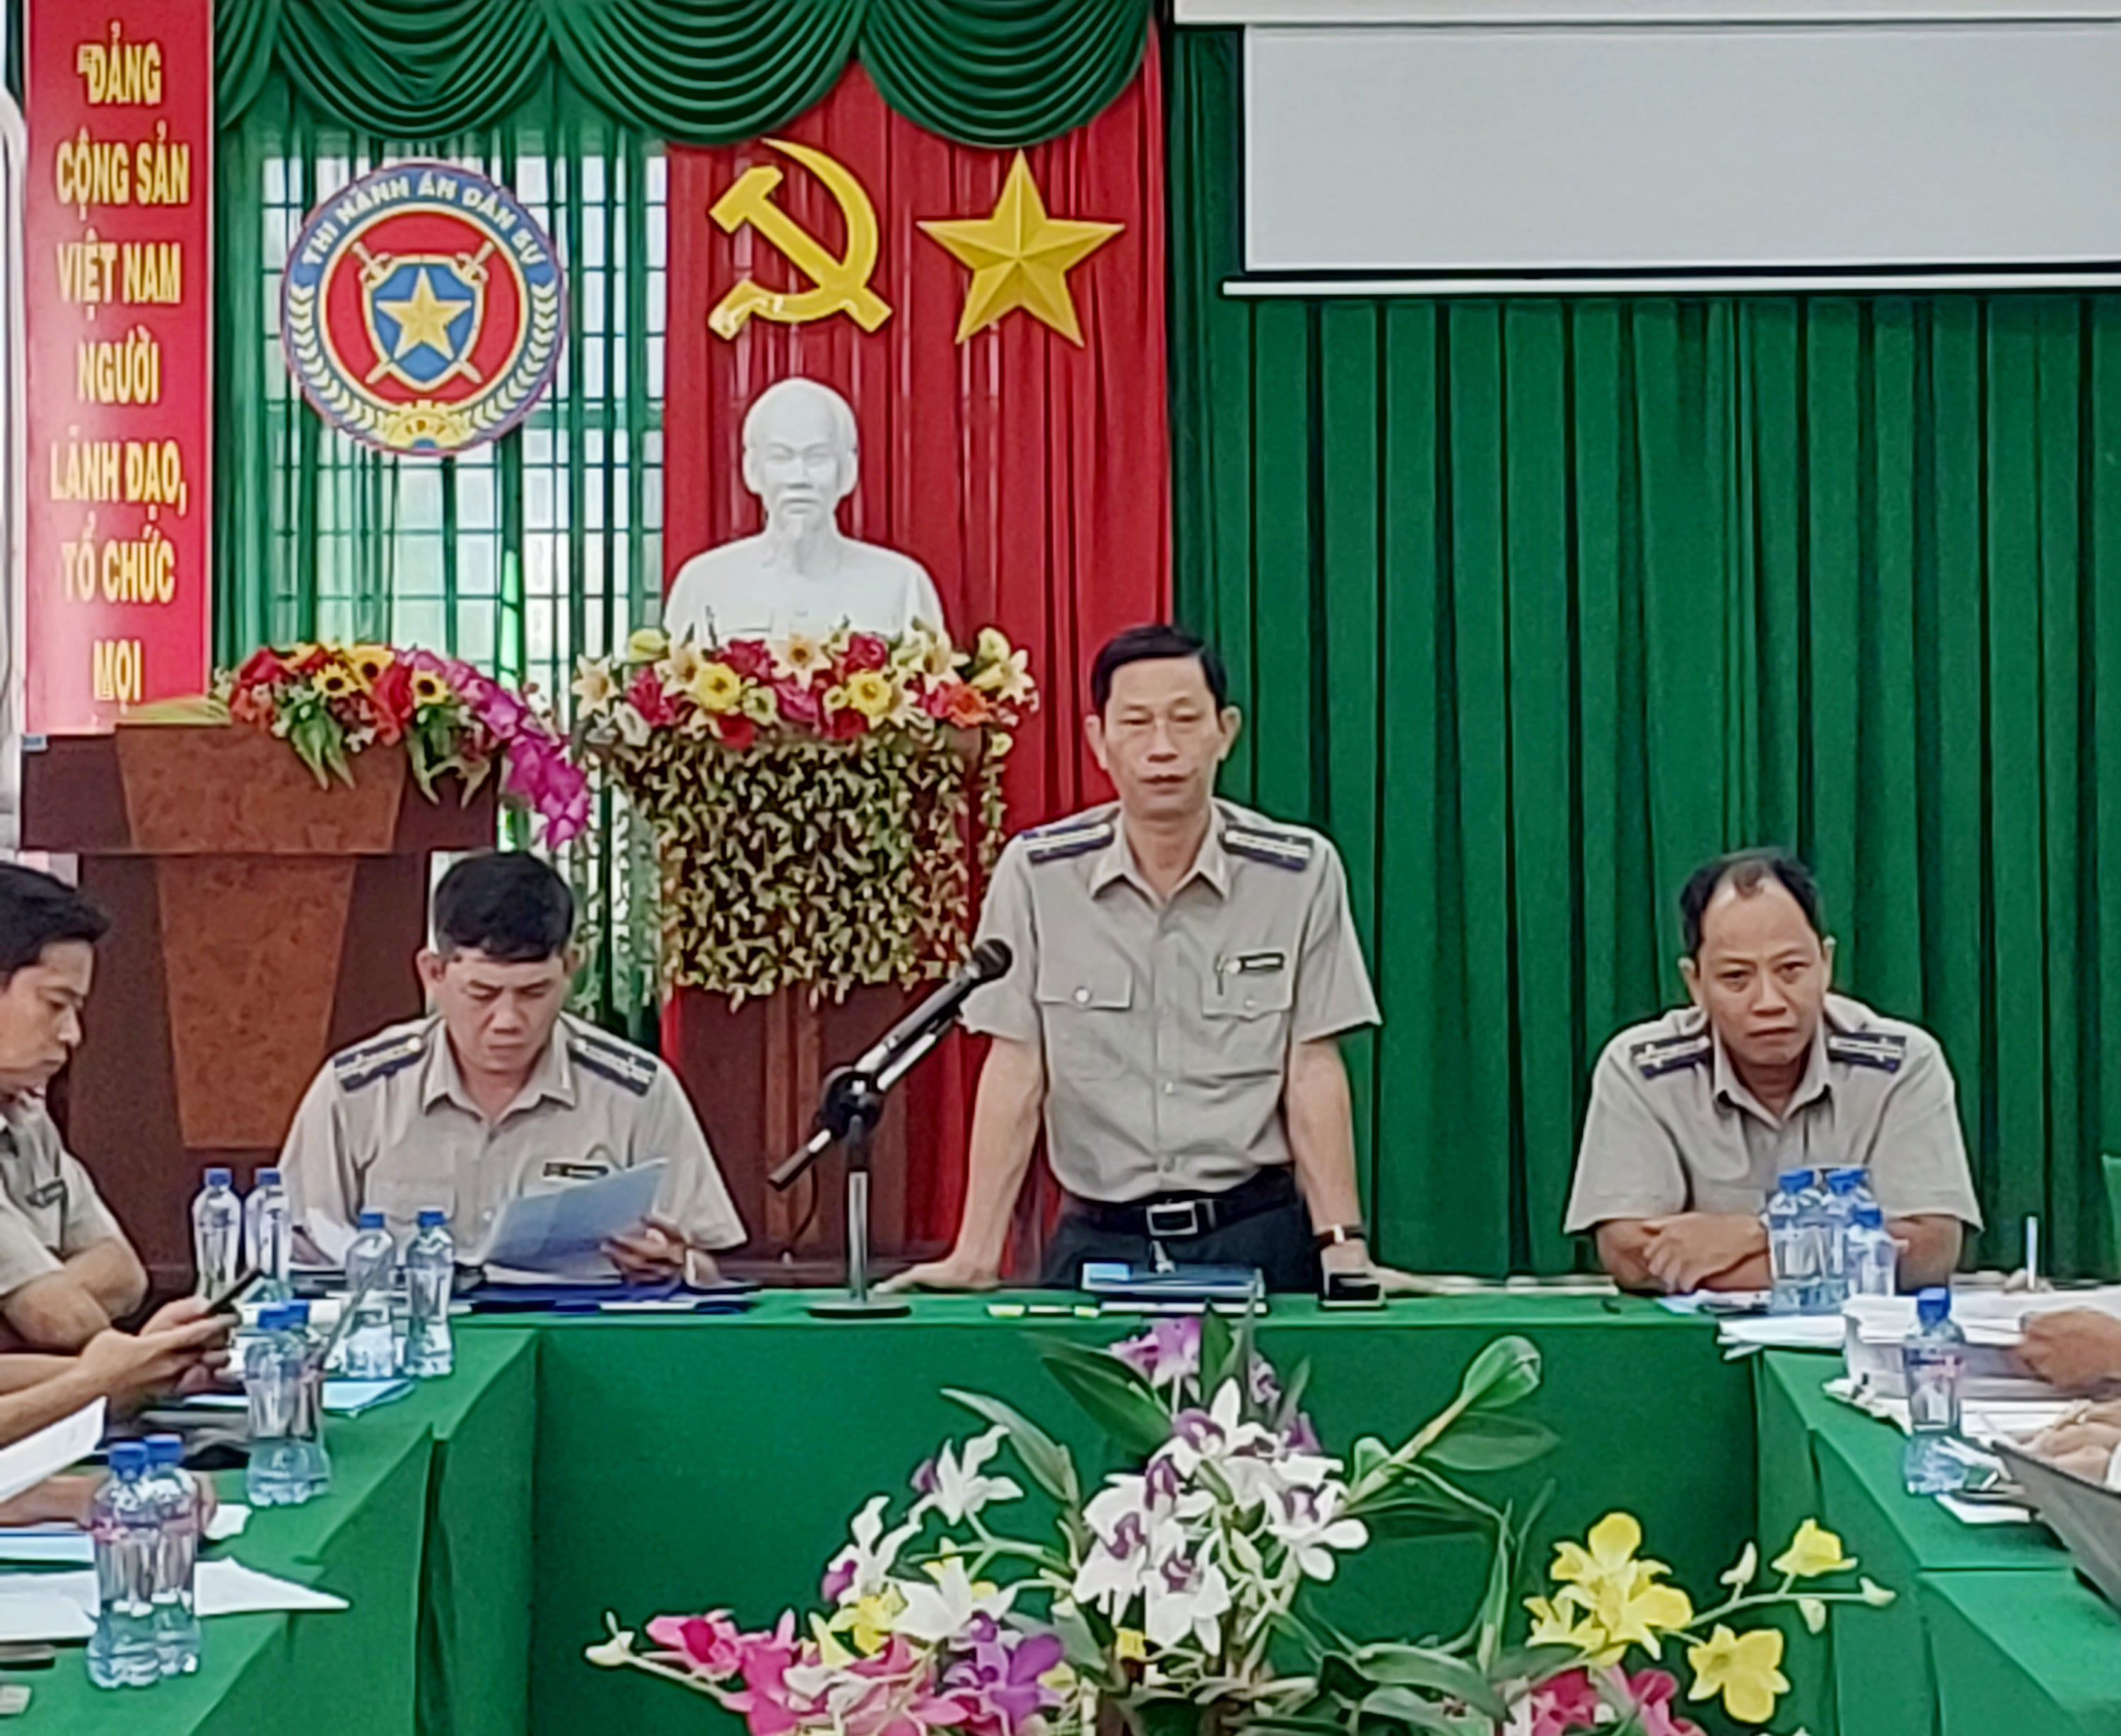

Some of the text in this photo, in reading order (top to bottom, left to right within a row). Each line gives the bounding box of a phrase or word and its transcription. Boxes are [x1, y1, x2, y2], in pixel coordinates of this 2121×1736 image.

[57, 119, 189, 221] CỘNG SẢN
[57, 227, 182, 321] VIỆT NAM
[78, 324, 159, 404] NGƯỜI
[51, 425, 187, 521] LÃNH ĐẠO,
[61, 510, 175, 604] TỔ CHỨC
[93, 638, 141, 716] MỌI
